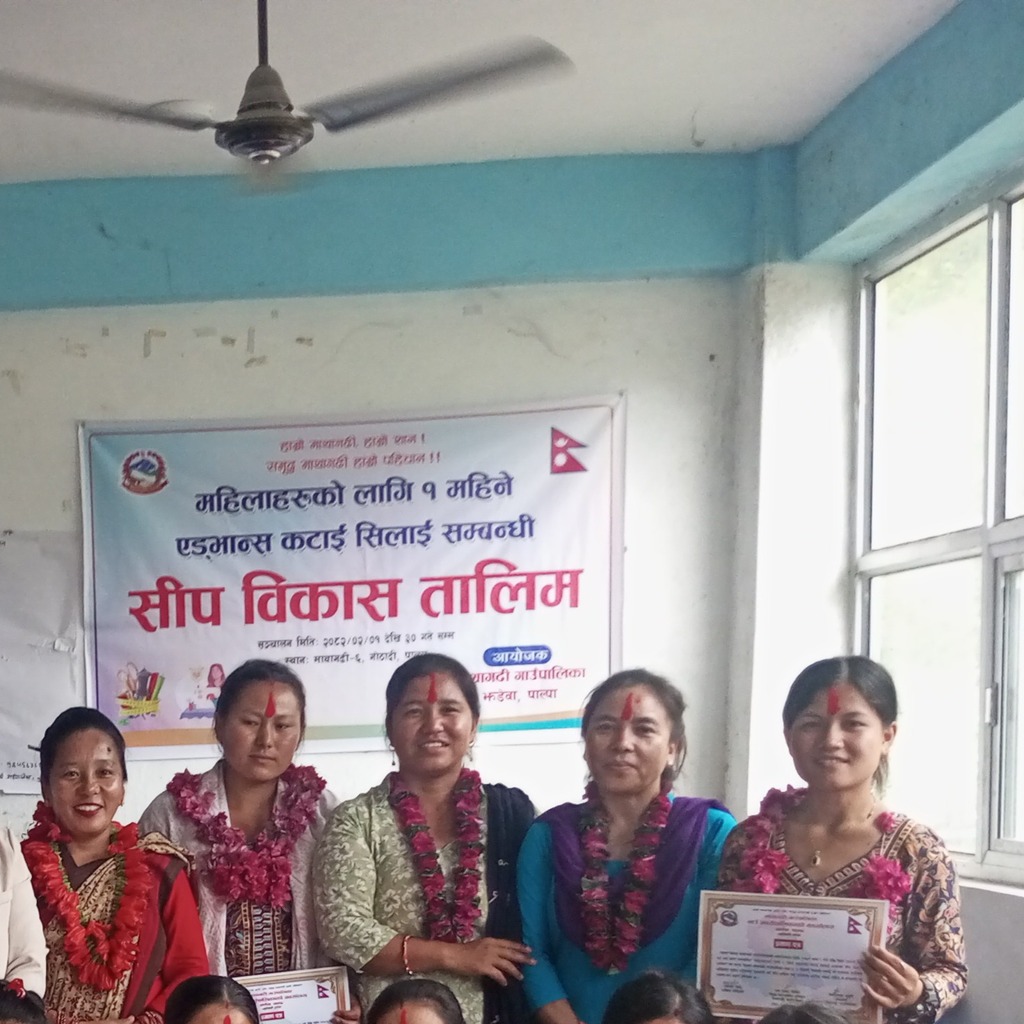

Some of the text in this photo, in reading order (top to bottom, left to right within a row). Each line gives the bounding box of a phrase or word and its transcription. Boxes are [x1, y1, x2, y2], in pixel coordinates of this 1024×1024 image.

[353, 476, 414, 505] लागि
[422, 481, 436, 501] १
[446, 470, 514, 500] महिने
[280, 523, 347, 551] कटाई
[355, 519, 433, 547] सिलाई
[128, 558, 584, 633] सीप विकास तालिम
[492, 648, 549, 663] आयोजक
